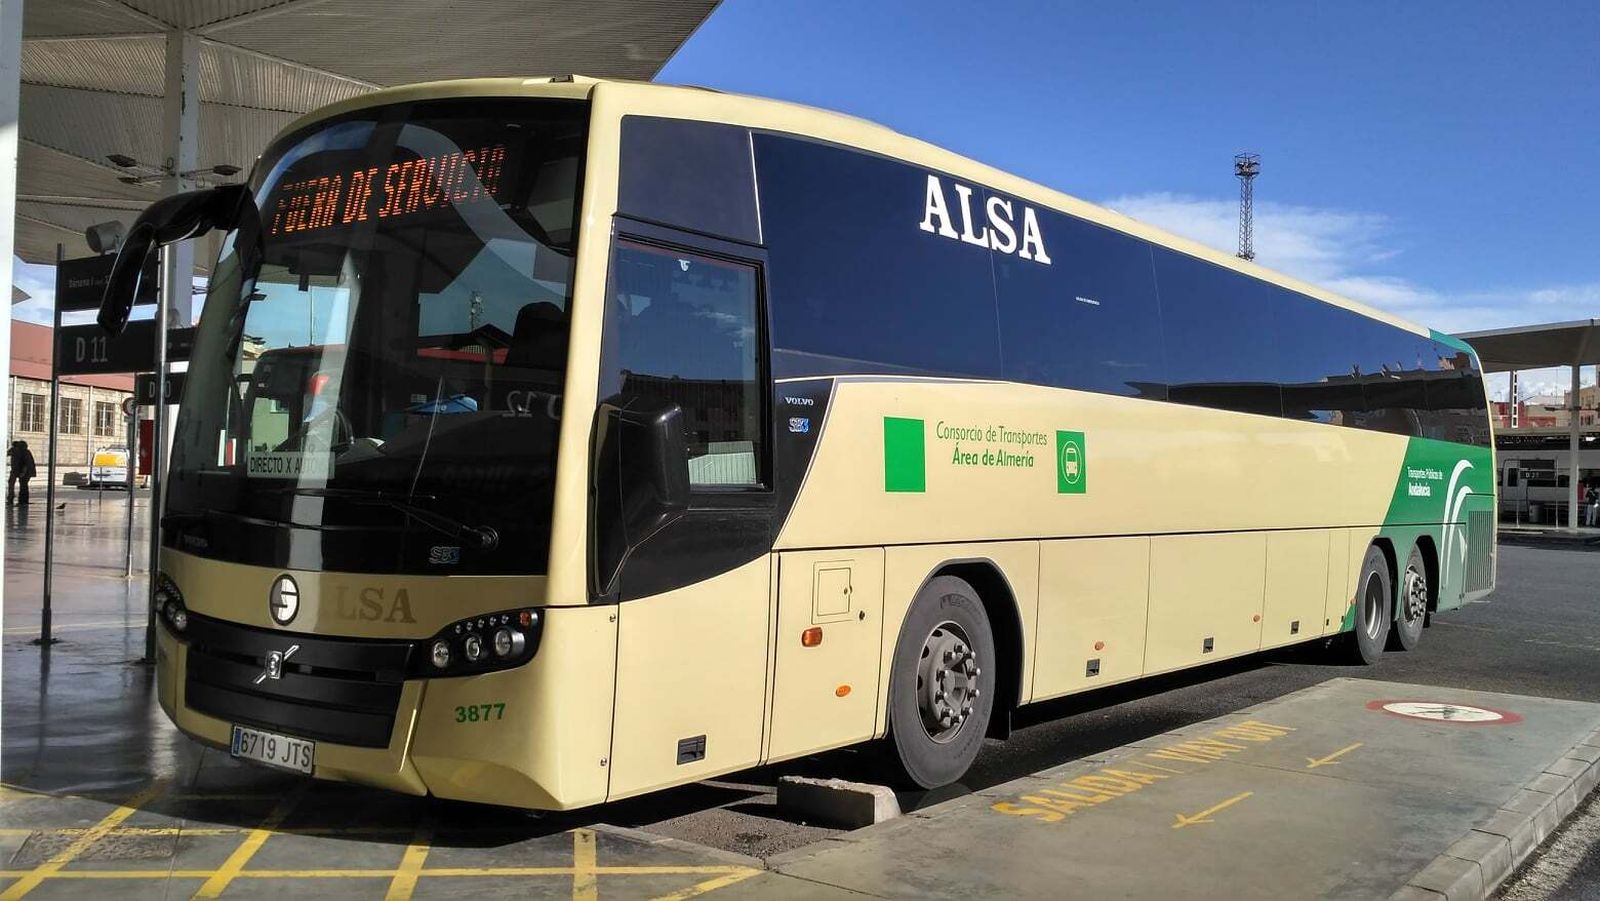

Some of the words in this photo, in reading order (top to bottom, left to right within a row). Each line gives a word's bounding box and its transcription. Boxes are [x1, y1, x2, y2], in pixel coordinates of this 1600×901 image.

[342, 168, 379, 224] DE
[919, 174, 1052, 265] ALSA
[75, 337, 86, 363] D
[91, 336, 109, 363] 11
[784, 396, 814, 406] VOLVO
[936, 420, 983, 441] Consorcio
[985, 425, 997, 442] de
[998, 425, 1048, 449] Transportes
[250, 456, 283, 473] DIRECTO
[286, 456, 293, 473] X
[952, 442, 978, 465] Área
[982, 448, 995, 466] de
[996, 449, 1034, 467] Almería
[332, 586, 417, 624] LSA
[454, 703, 506, 723] 3877
[241, 732, 276, 760] 6719
[282, 741, 311, 768] JTS
[990, 769, 1169, 823] SALIDA
[1145, 736, 1248, 764] WAY
[1214, 719, 1297, 742] OUT
